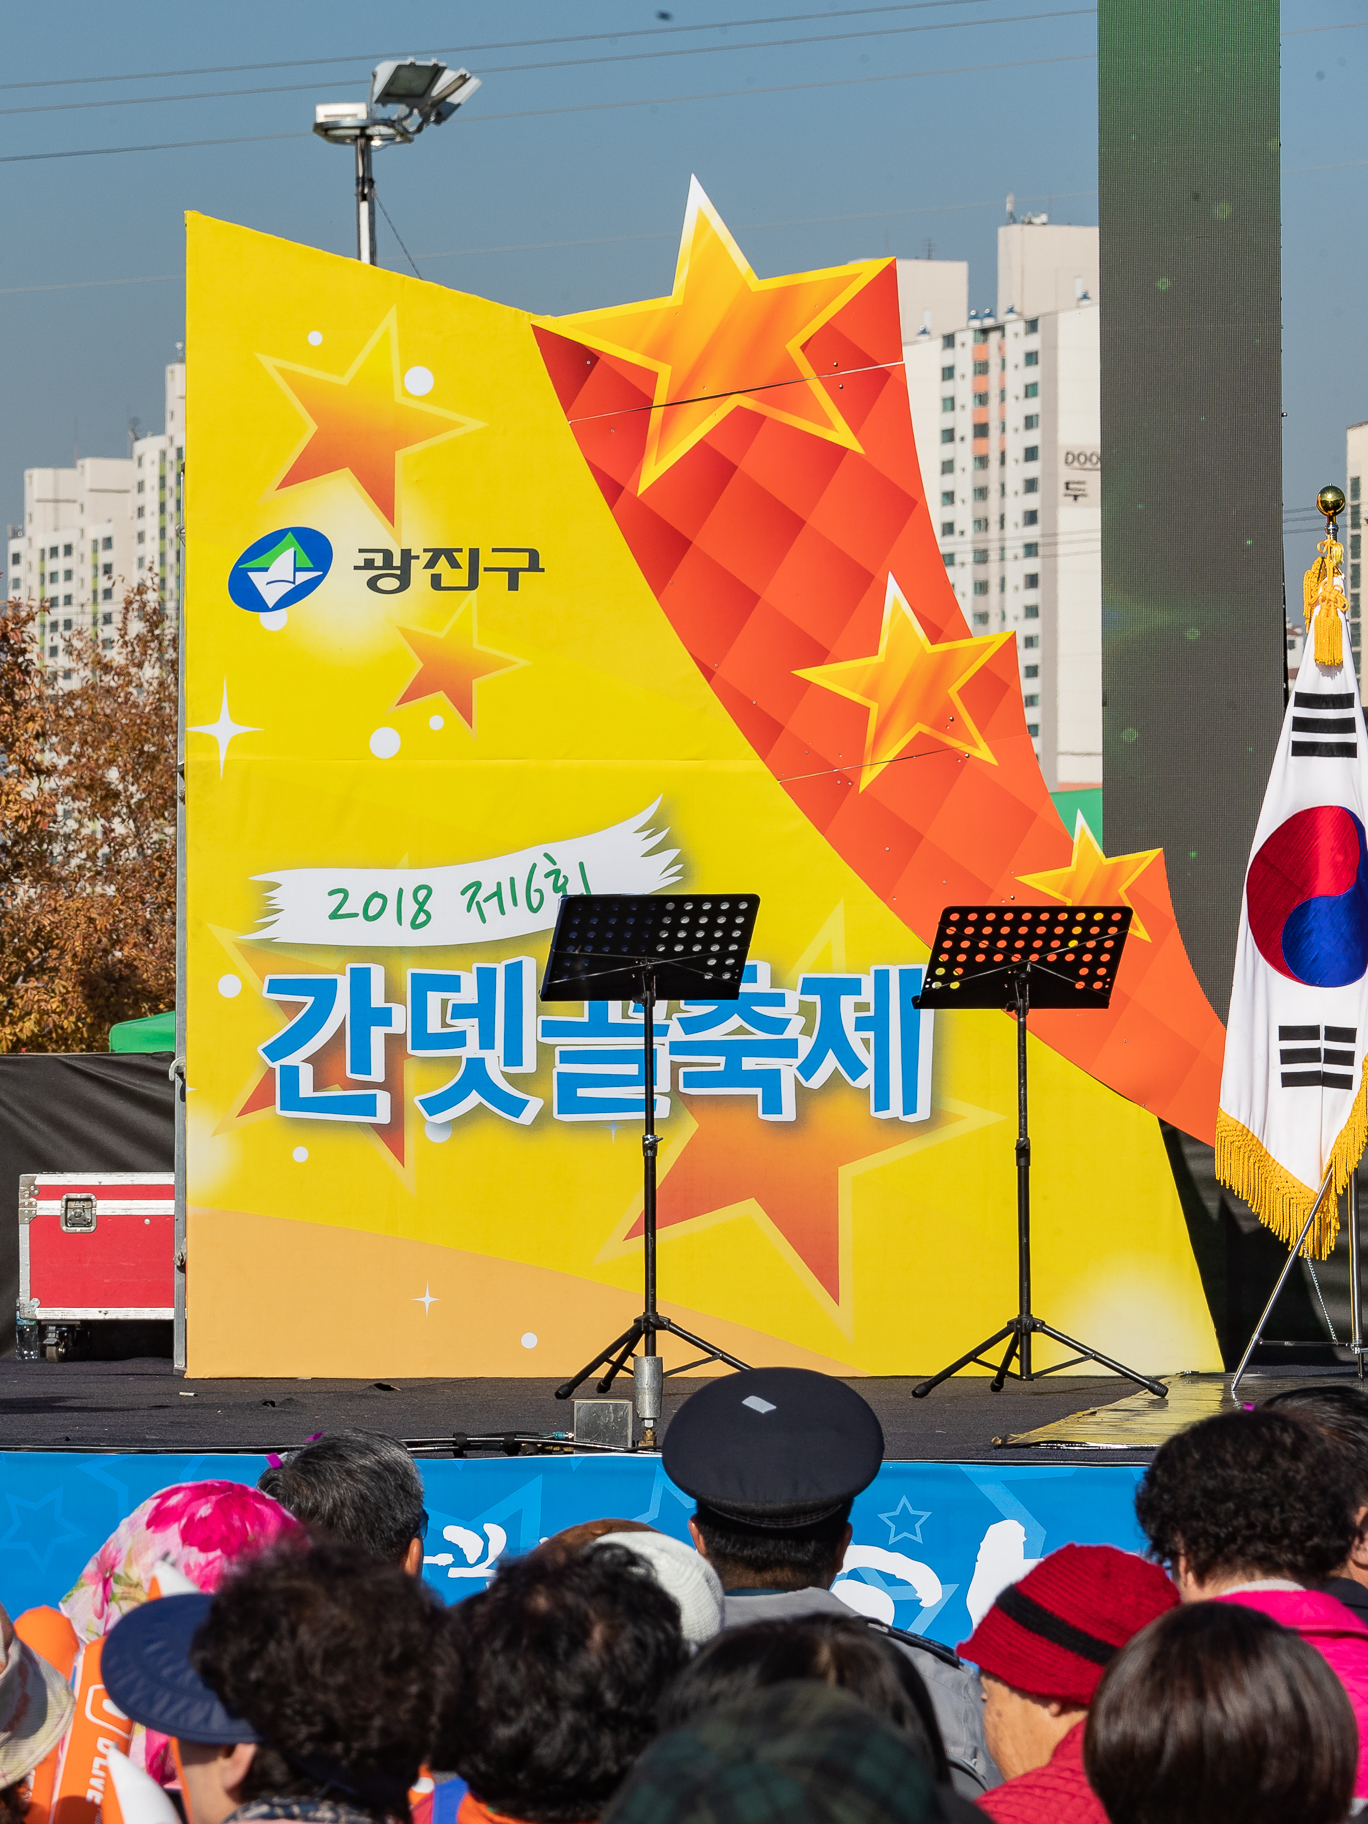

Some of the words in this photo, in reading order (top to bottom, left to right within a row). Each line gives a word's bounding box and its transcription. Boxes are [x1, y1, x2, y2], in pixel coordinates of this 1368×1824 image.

[353, 547, 546, 595] 광진구
[327, 884, 433, 930] 2018
[460, 852, 592, 924] 제6회
[256, 955, 933, 1126] 간뎃골축제
